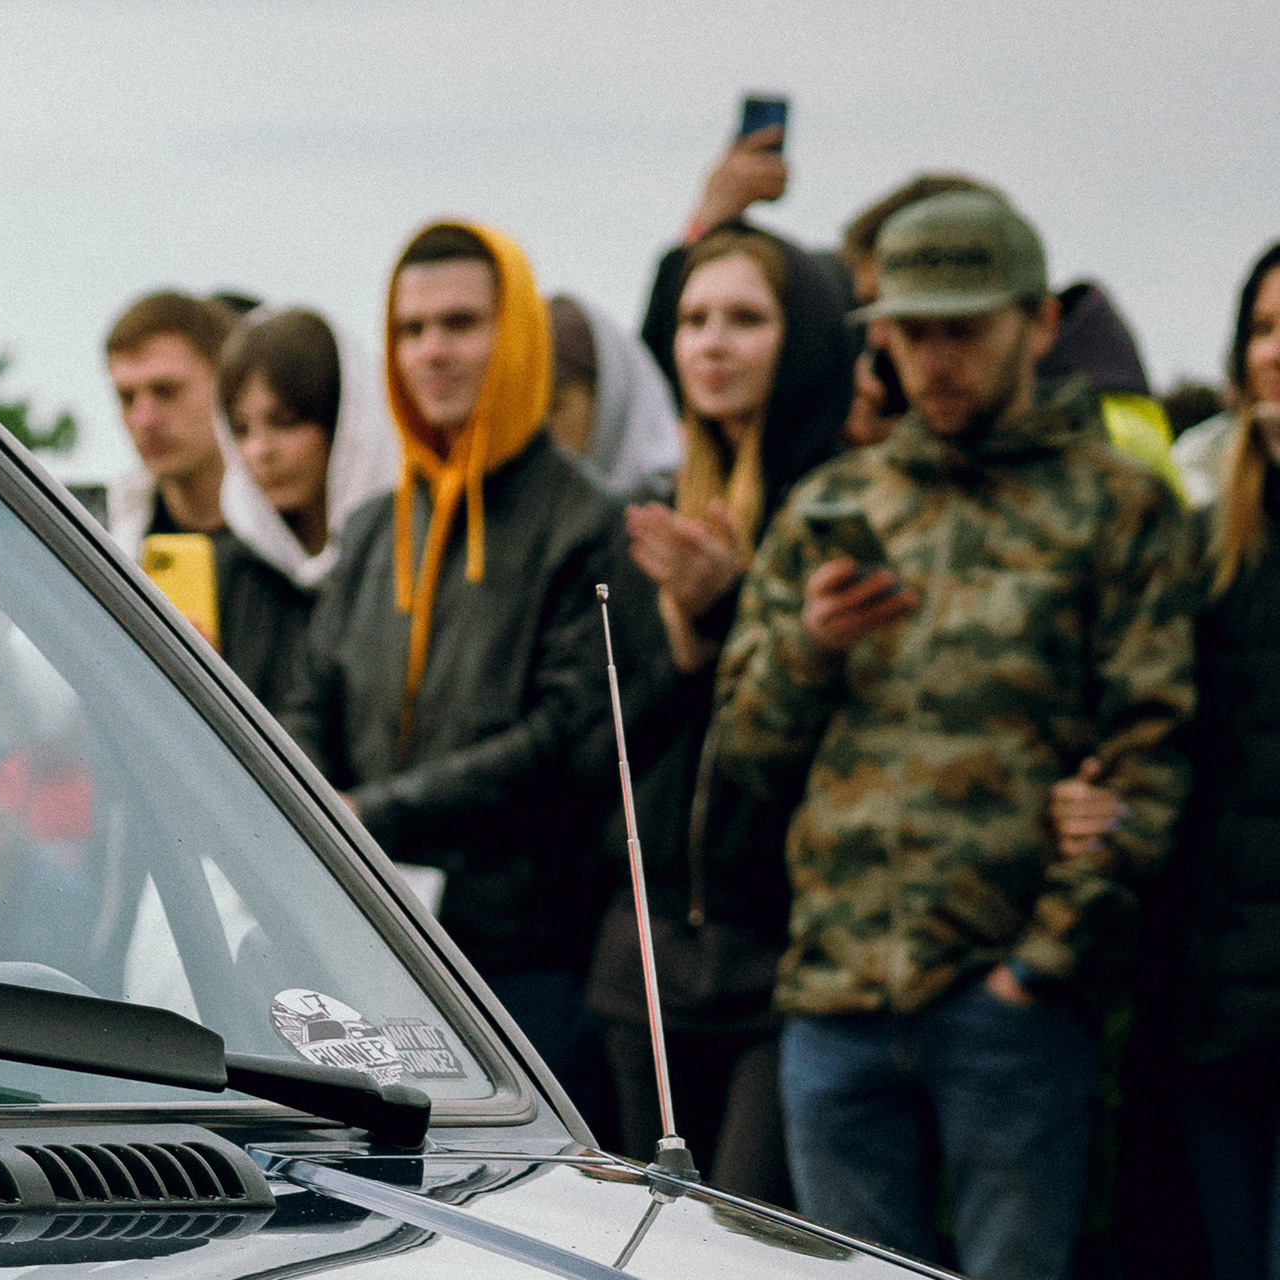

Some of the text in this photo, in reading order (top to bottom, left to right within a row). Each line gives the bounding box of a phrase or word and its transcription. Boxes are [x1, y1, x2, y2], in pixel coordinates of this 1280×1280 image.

[411, 1025, 446, 1049] NOT
[309, 1040, 397, 1067] WINNER
[399, 1049, 460, 1073] STANCE?
